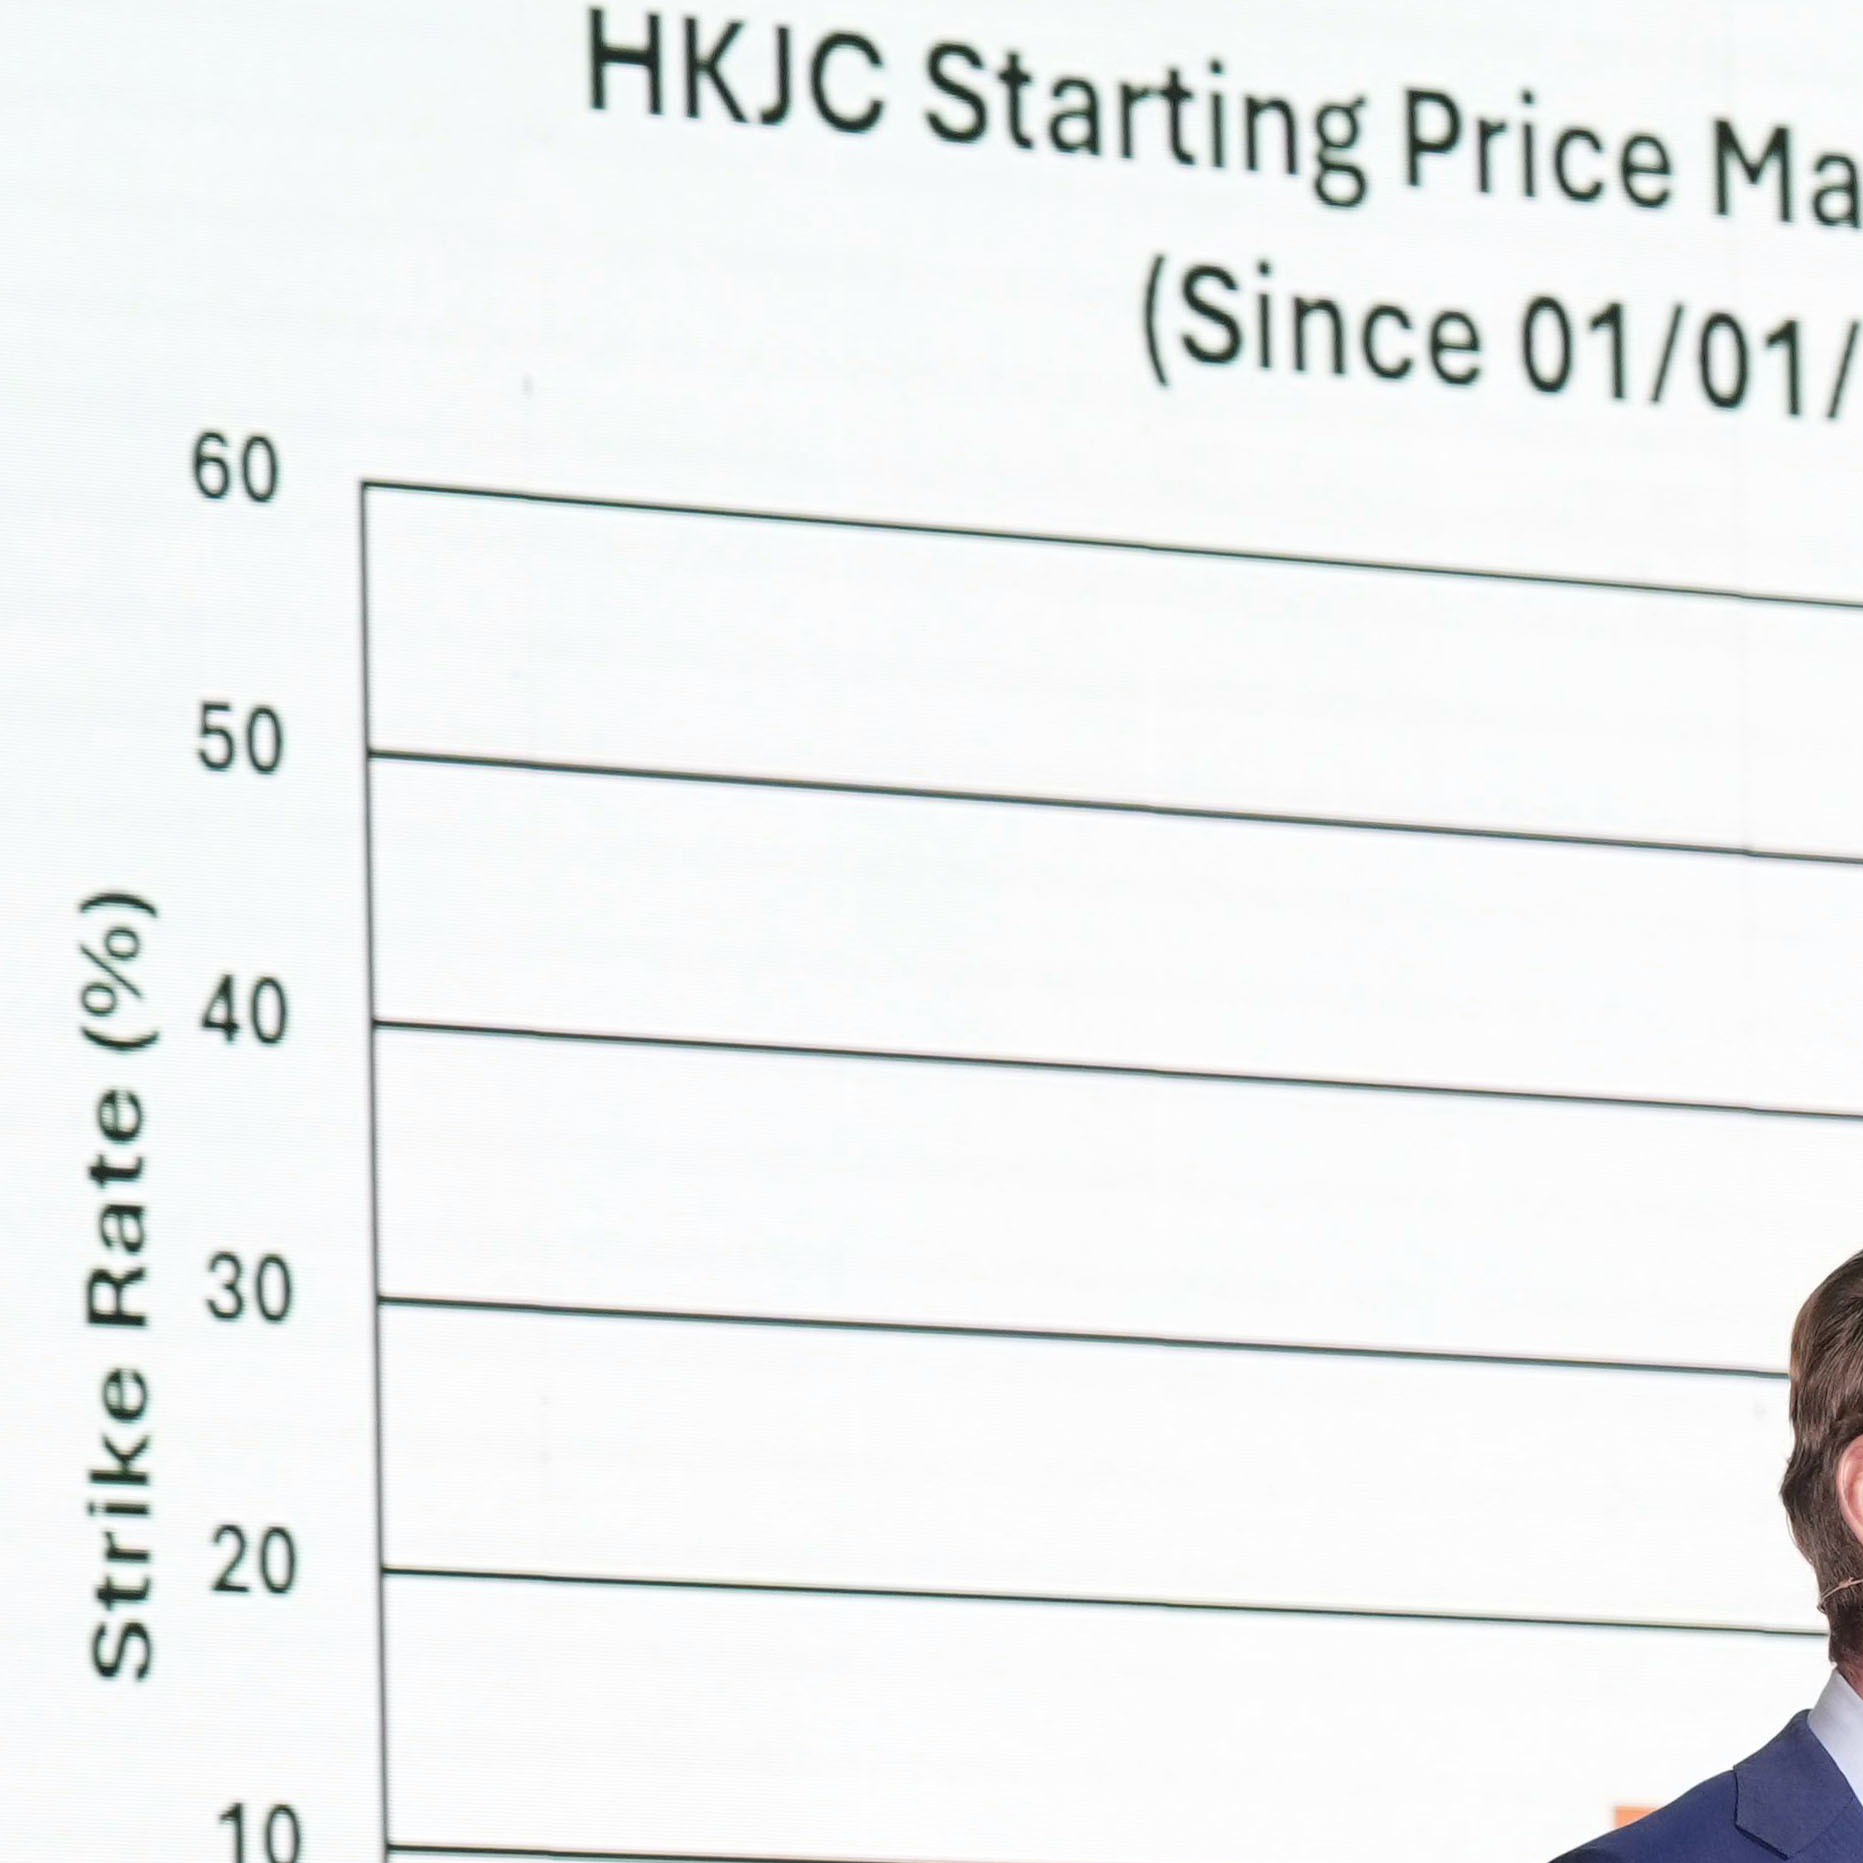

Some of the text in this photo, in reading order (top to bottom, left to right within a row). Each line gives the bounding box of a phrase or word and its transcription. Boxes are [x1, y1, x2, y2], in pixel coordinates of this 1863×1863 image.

[589, 7, 884, 134] HKJC
[926, 42, 1368, 209] Starting
[1405, 88, 1672, 209] Price
[1143, 255, 1481, 386] (Since
[192, 431, 279, 503] 60
[198, 701, 284, 775] 50
[201, 974, 288, 1046] 40
[79, 892, 159, 1681] Strike Rate (%)
[206, 1251, 293, 1324] 30
[212, 1524, 297, 1595] 20
